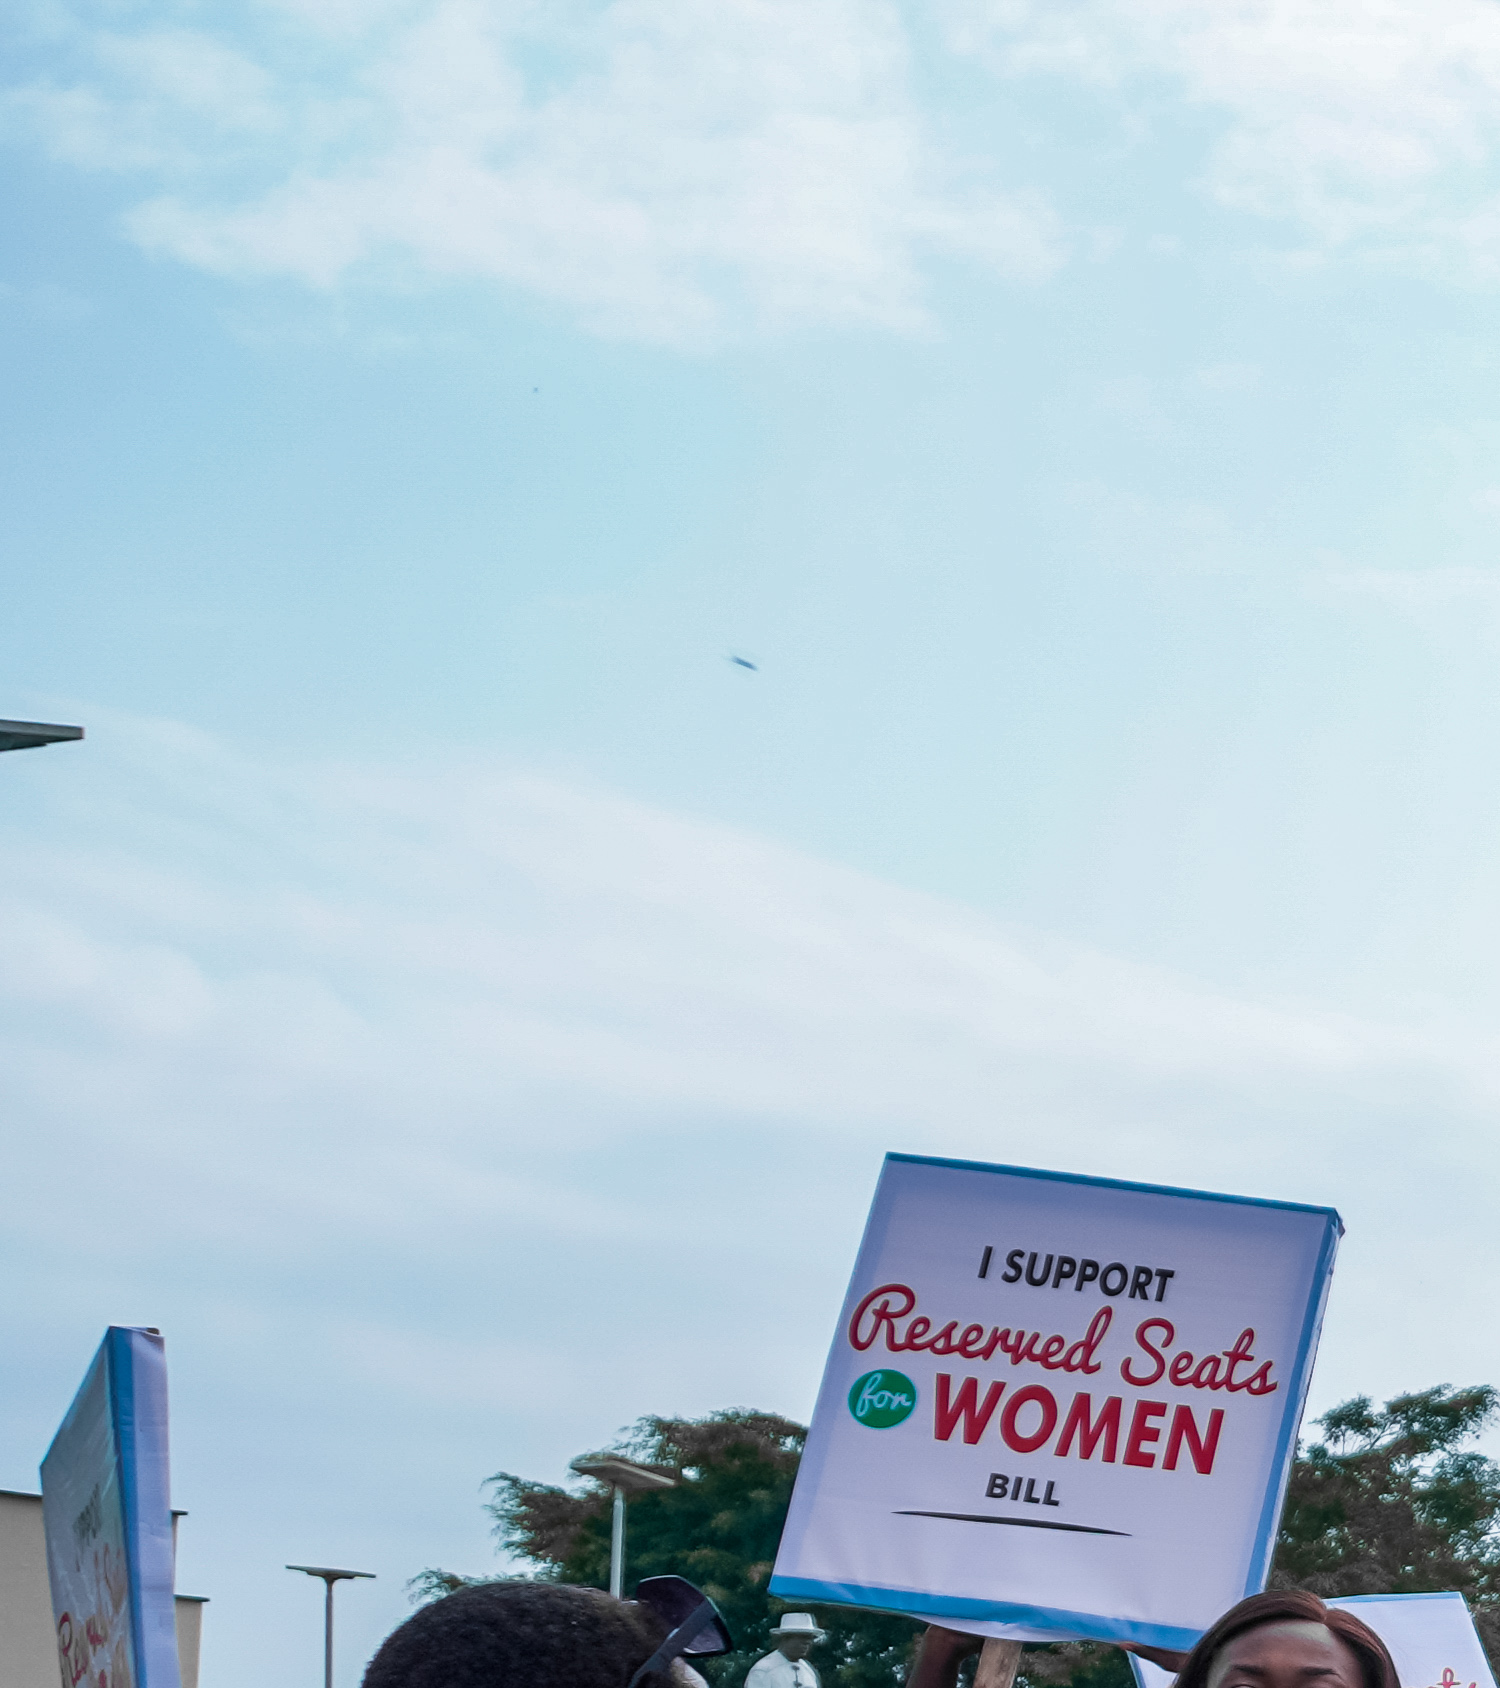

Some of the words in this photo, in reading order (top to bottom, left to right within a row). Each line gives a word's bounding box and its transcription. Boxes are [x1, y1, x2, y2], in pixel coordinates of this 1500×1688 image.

[977, 1245, 993, 1280] I
[1002, 1249, 1174, 1302] SUPPORT
[849, 1284, 1114, 1375] Reserved
[1120, 1317, 1278, 1397] Seats
[855, 1374, 917, 1415] for
[933, 1373, 1224, 1475] WOMEN
[985, 1473, 1060, 1507] BILL
